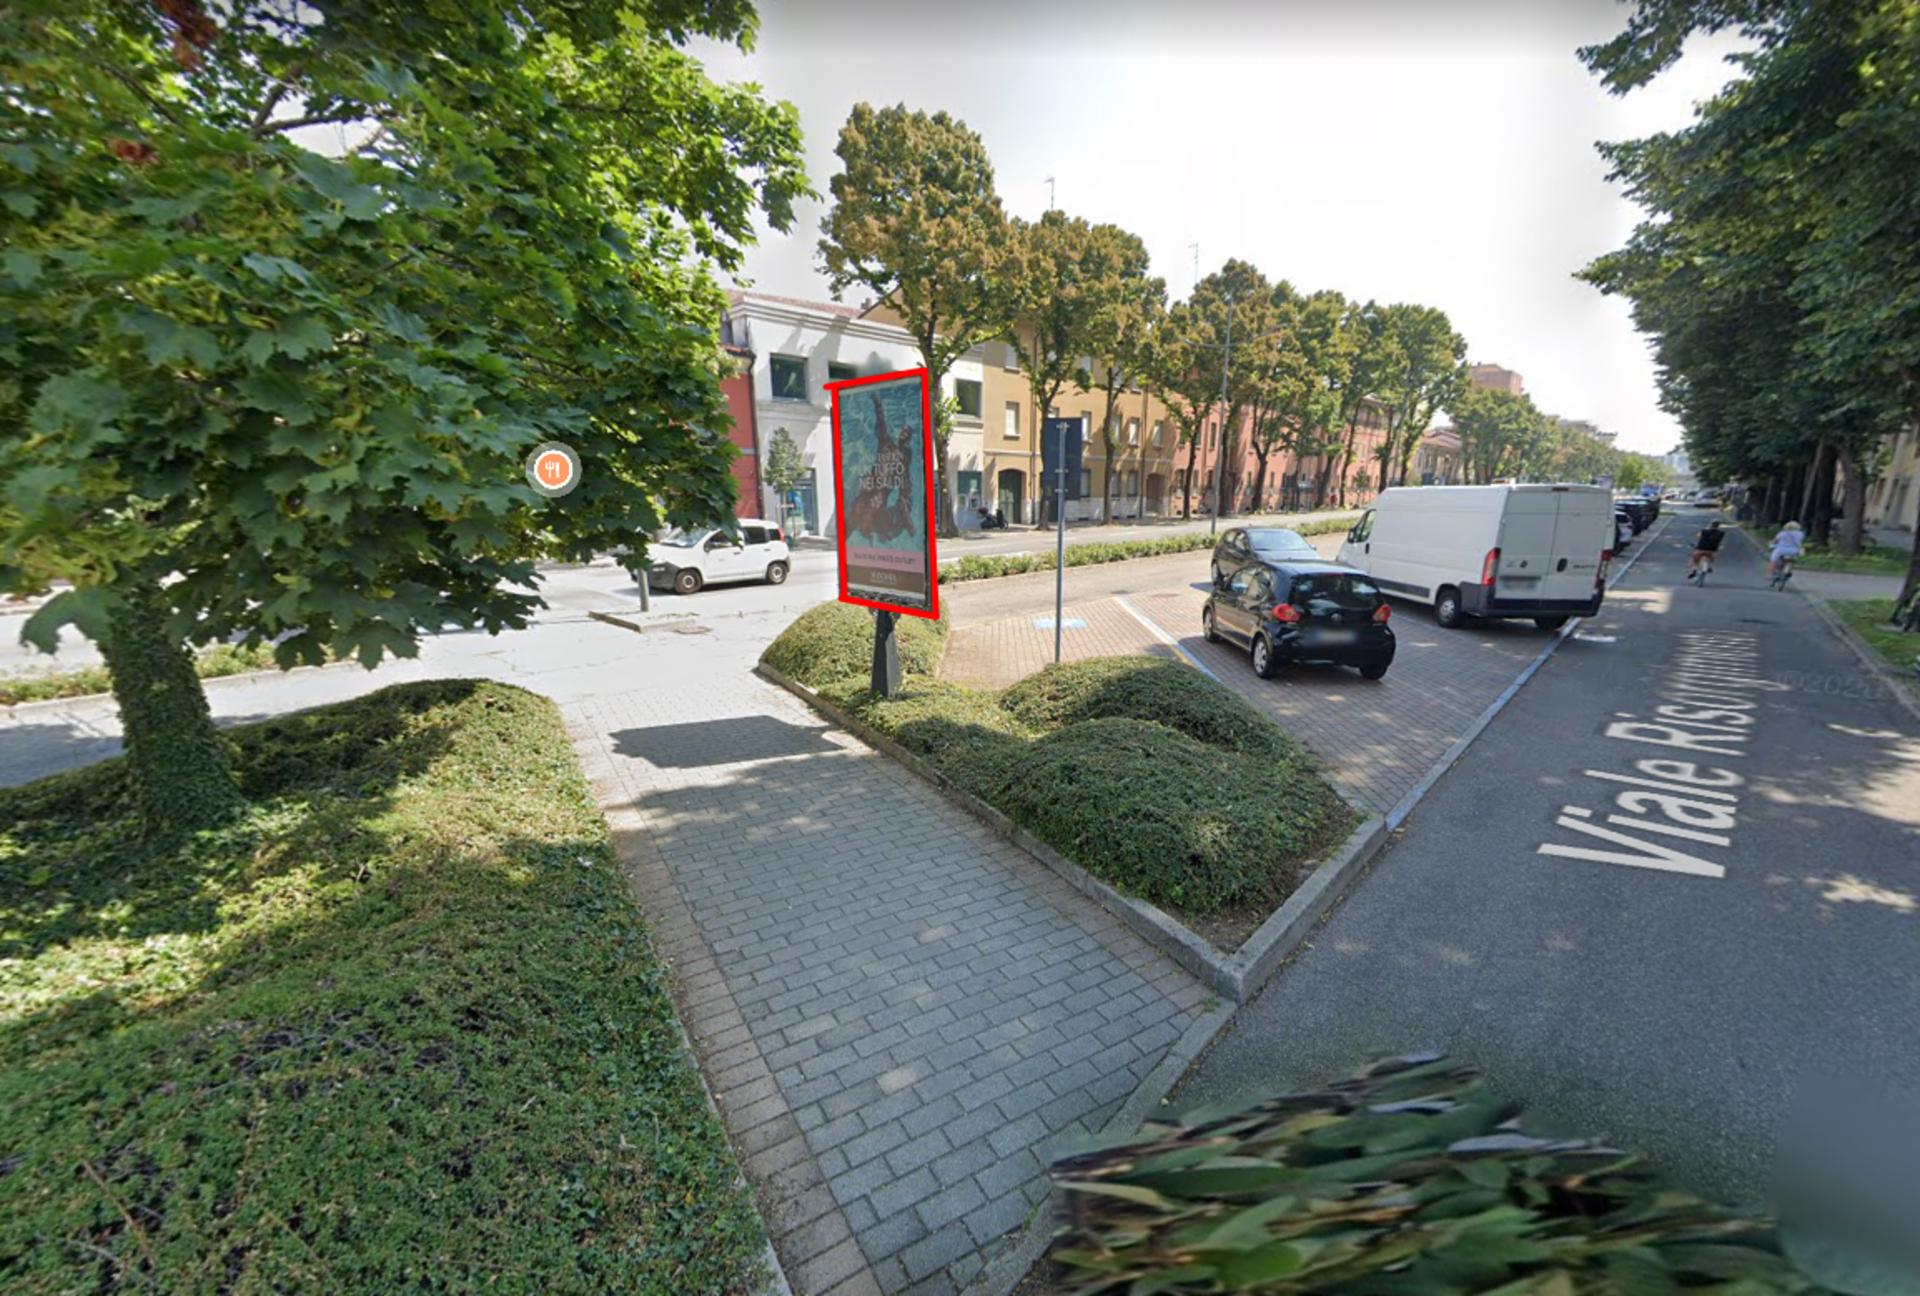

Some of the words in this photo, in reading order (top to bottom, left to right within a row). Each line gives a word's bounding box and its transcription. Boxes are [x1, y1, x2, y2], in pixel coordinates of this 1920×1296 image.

[873, 461, 905, 478] TUFFO
[859, 476, 875, 490] NEI
[876, 475, 905, 490] SALDI
